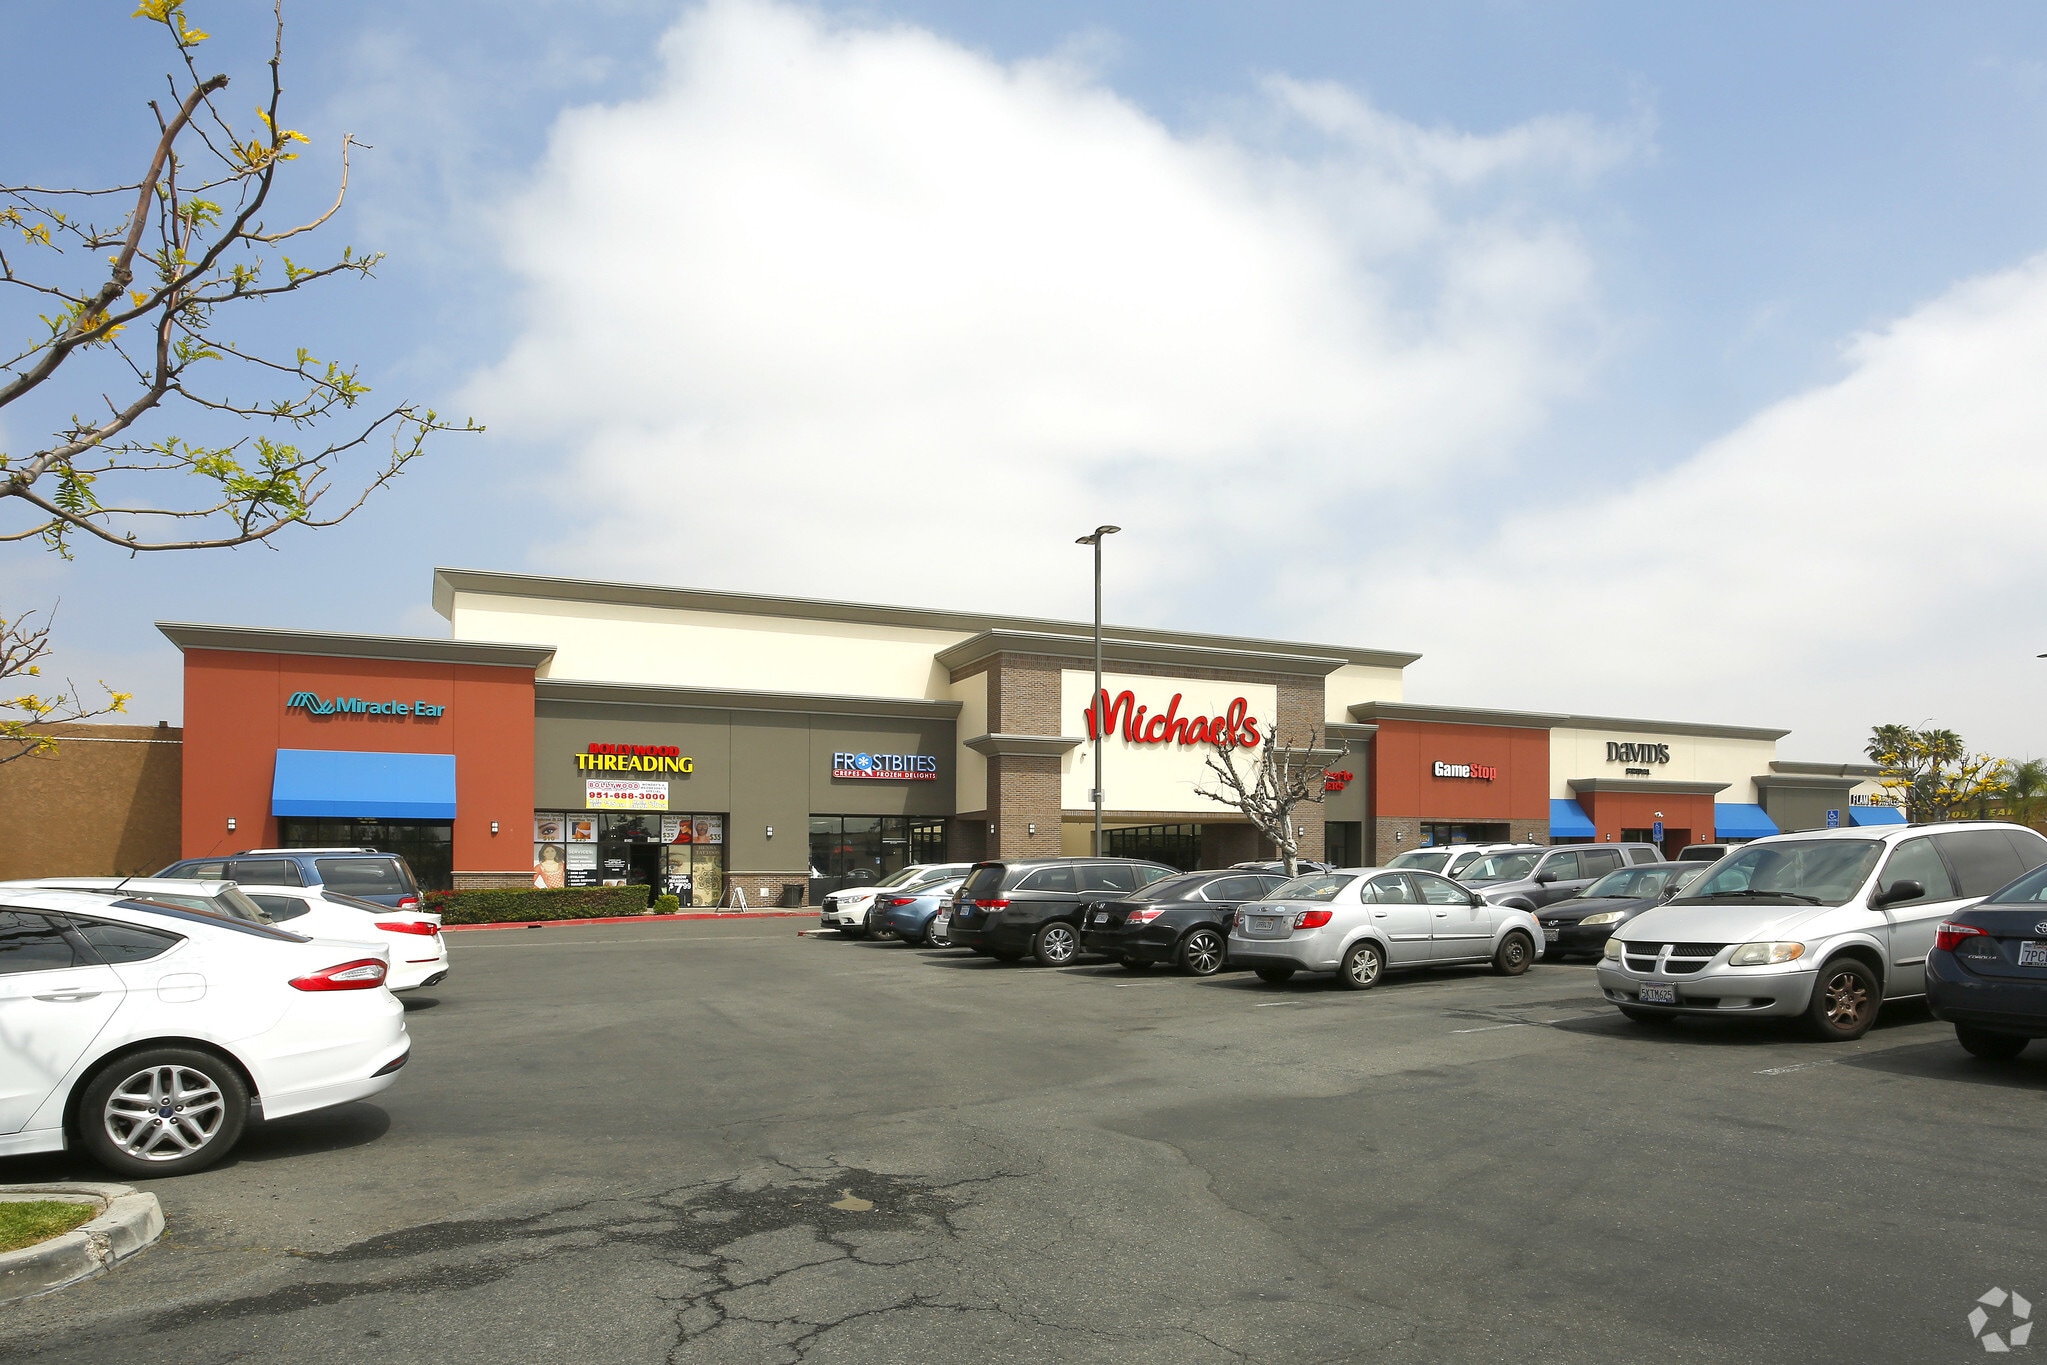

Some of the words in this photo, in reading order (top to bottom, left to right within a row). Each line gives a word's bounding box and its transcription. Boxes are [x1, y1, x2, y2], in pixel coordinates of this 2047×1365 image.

[336, 697, 445, 717] Miracle-Ear
[1085, 689, 1260, 747] Michaels
[588, 743, 680, 756] BOLLYWOOD
[576, 753, 693, 773] THREADING
[834, 752, 936, 772] FROSTBITES
[1434, 761, 1497, 780] GameStop
[588, 781, 640, 789] BOLLYWOOD
[1325, 782, 1345, 791] ERS
[589, 791, 665, 800] 951-688-3000
[2024, 950, 2047, 963] 7PC
